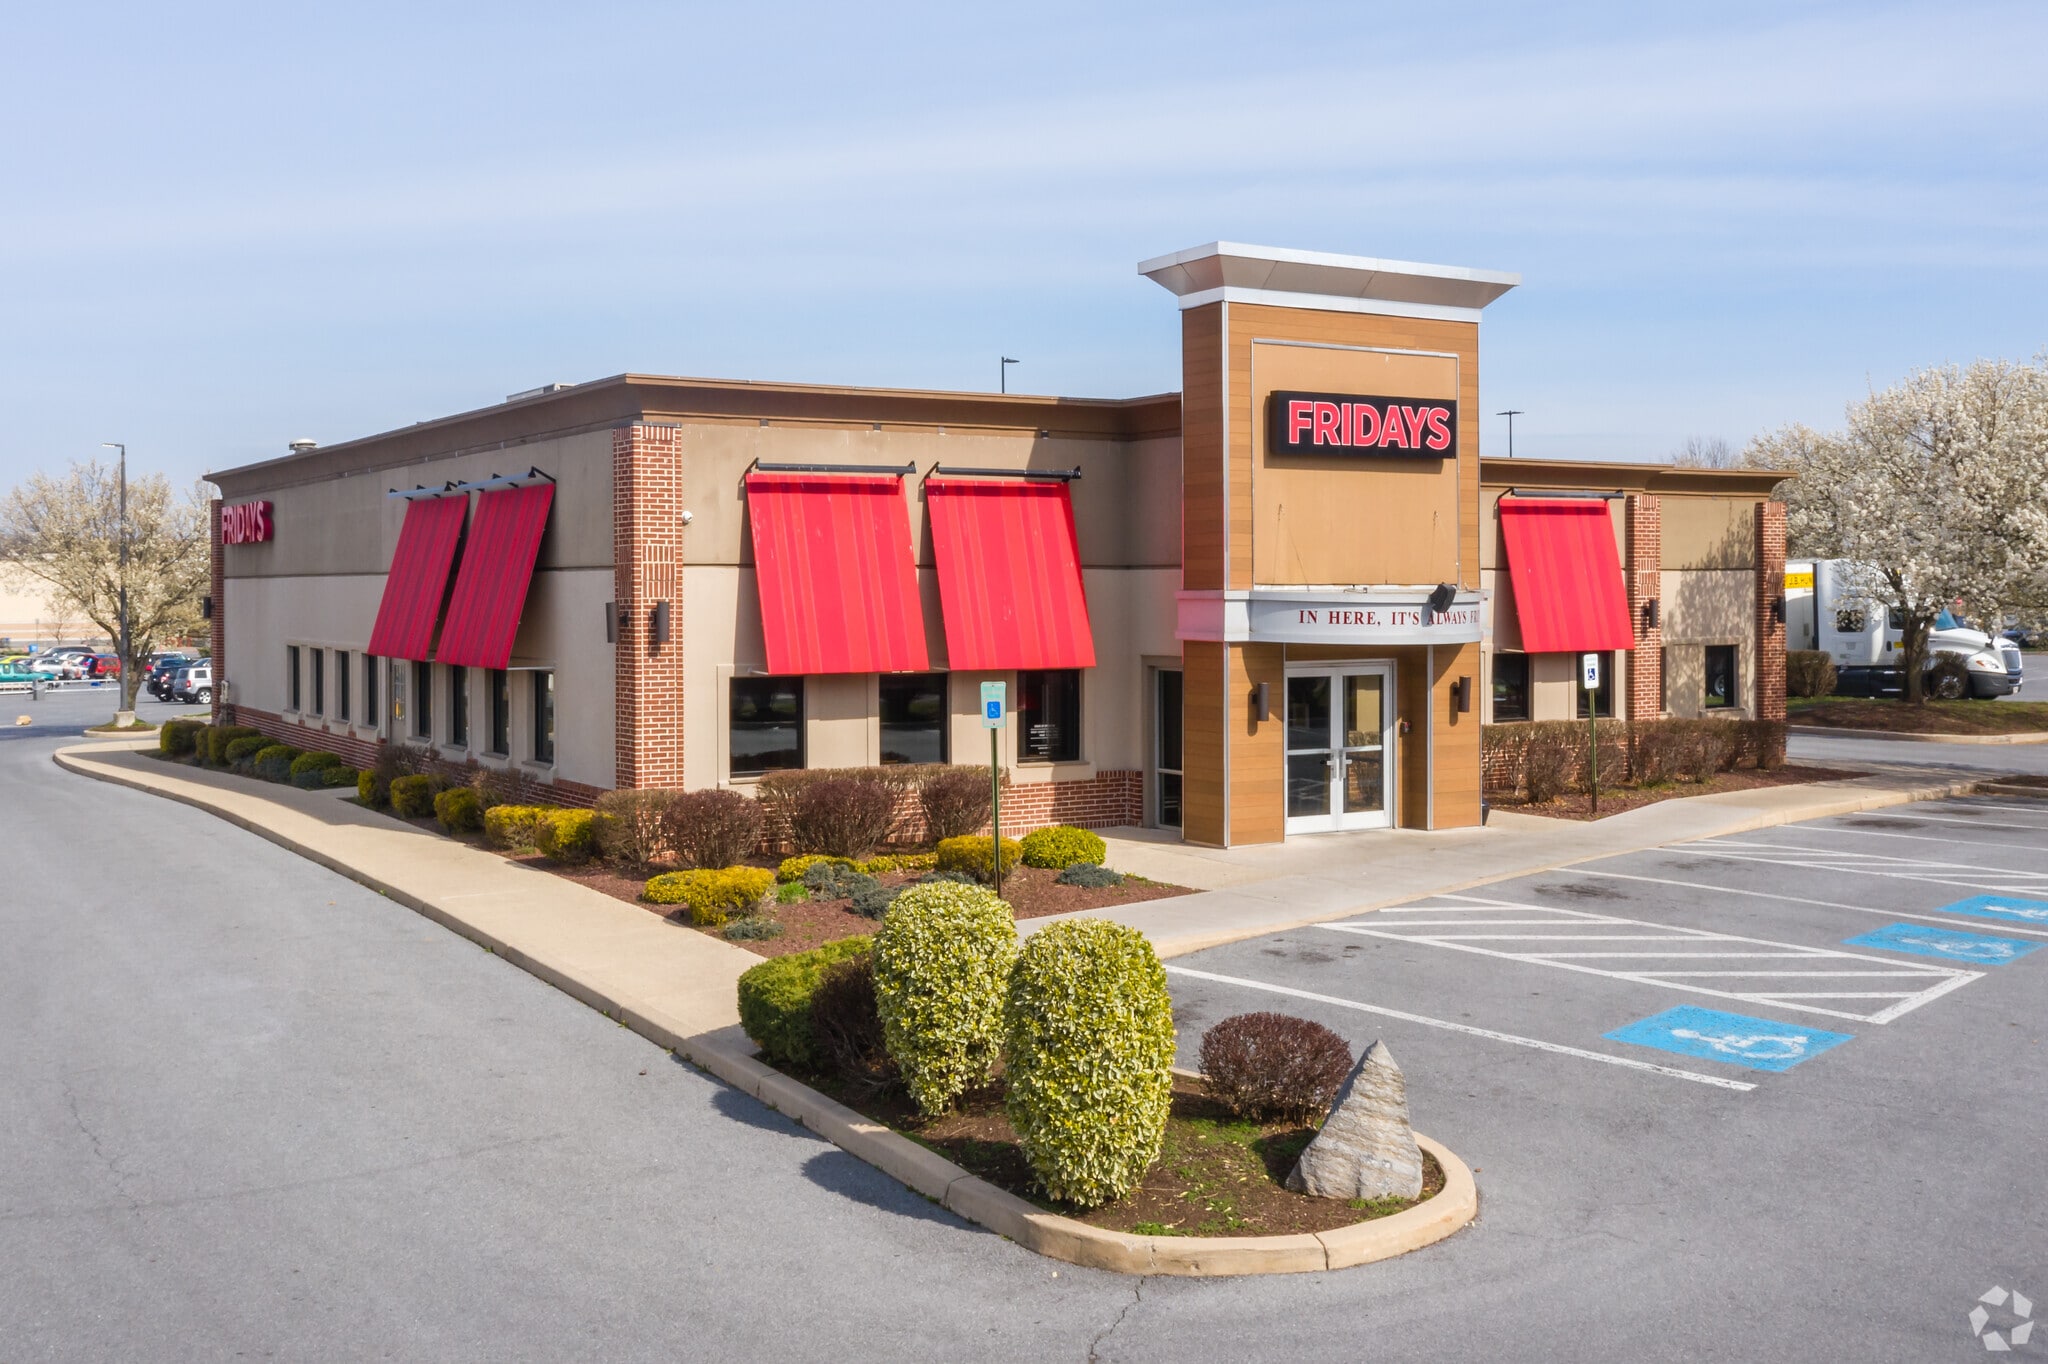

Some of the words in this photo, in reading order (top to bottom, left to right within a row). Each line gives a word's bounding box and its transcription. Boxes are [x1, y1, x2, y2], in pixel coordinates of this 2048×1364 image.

[1288, 400, 1451, 450] FRIDAYS
[221, 501, 265, 544] FRIDAYS
[1299, 610, 1318, 624] IN
[1328, 611, 1381, 626] HERE,
[1392, 611, 1420, 626] IT'S
[1427, 610, 1467, 626] ALWAYS
